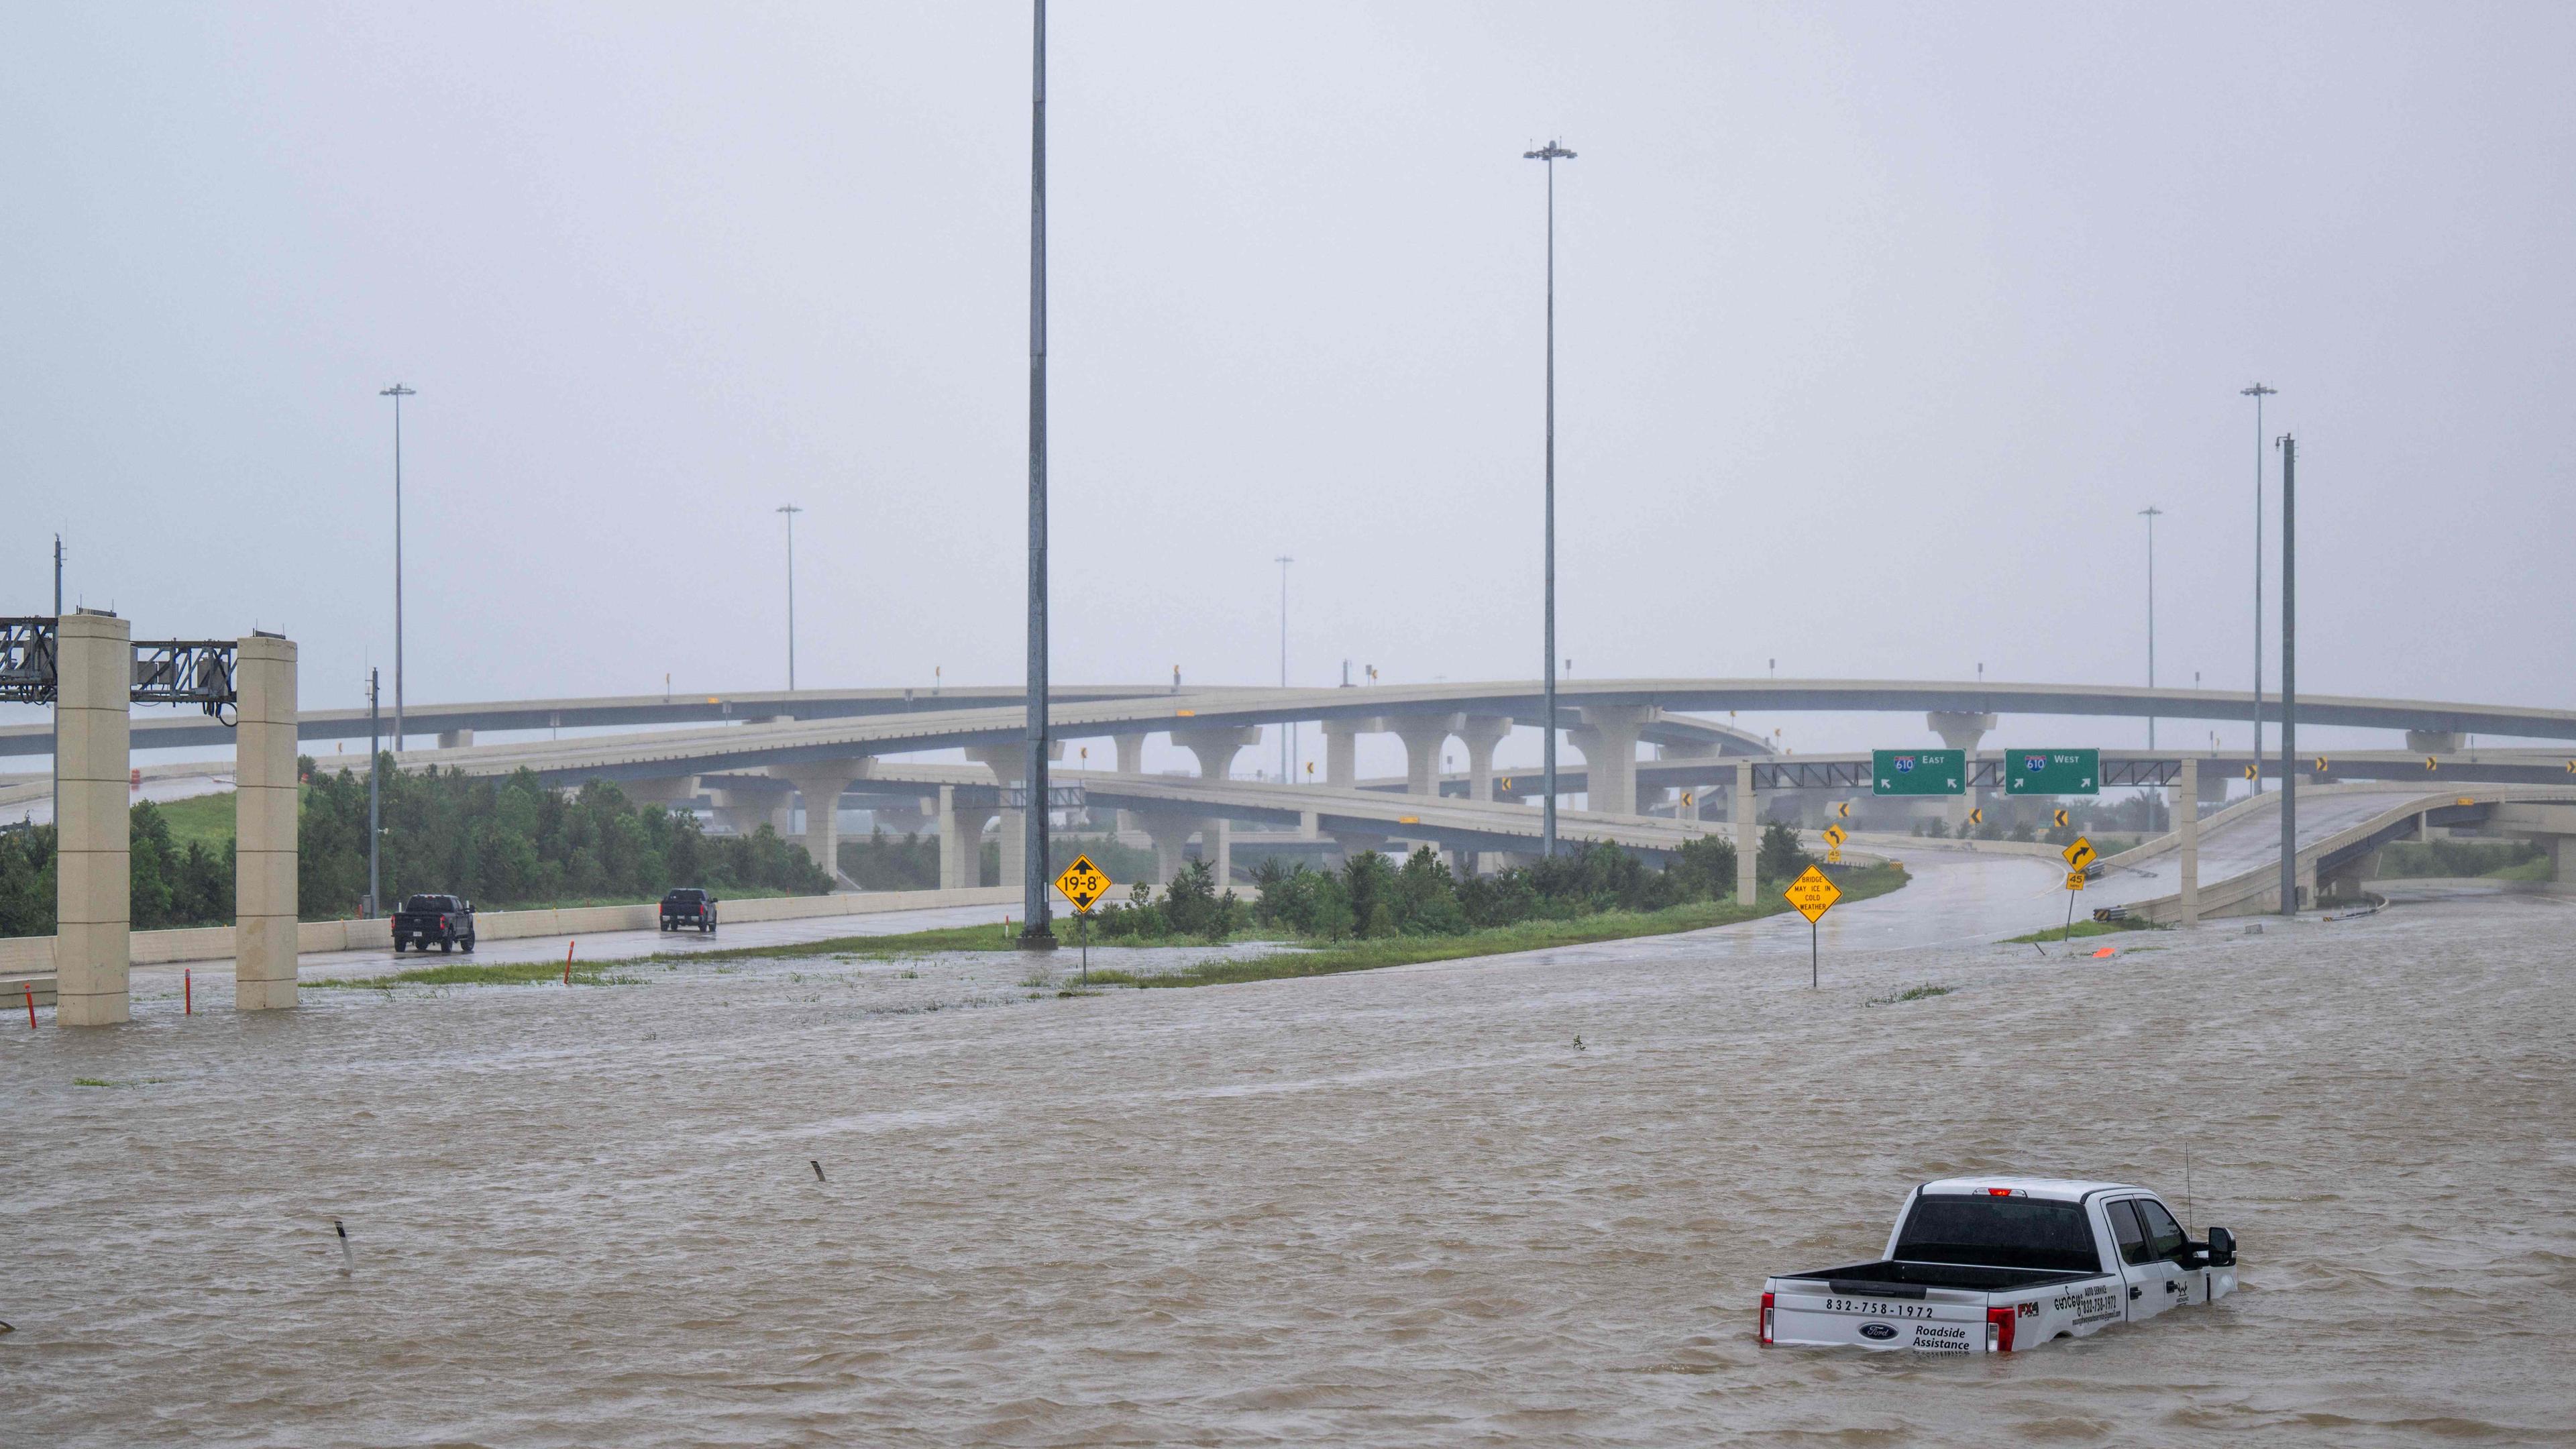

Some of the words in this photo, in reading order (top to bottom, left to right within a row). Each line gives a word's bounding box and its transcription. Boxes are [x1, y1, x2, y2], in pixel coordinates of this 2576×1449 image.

[1896, 760, 1913, 769] 610
[1922, 755, 1945, 764] EAST
[2027, 759, 2045, 769] 610
[2053, 755, 2080, 763] WEST
[1064, 876, 1101, 891] 19'-8"
[2070, 875, 2083, 883] 45
[2084, 1287, 2094, 1297] AUTO
[2094, 1285, 2107, 1295] SERVICE
[1826, 1299, 1933, 1319] 832-758-1972
[2017, 1301, 2039, 1318] FX4
[2083, 1295, 2116, 1314] 832-758-1972
[1868, 1326, 1889, 1337] Ford
[1915, 1326, 1966, 1338] Roadside
[1913, 1337, 1970, 1350] Assistance
